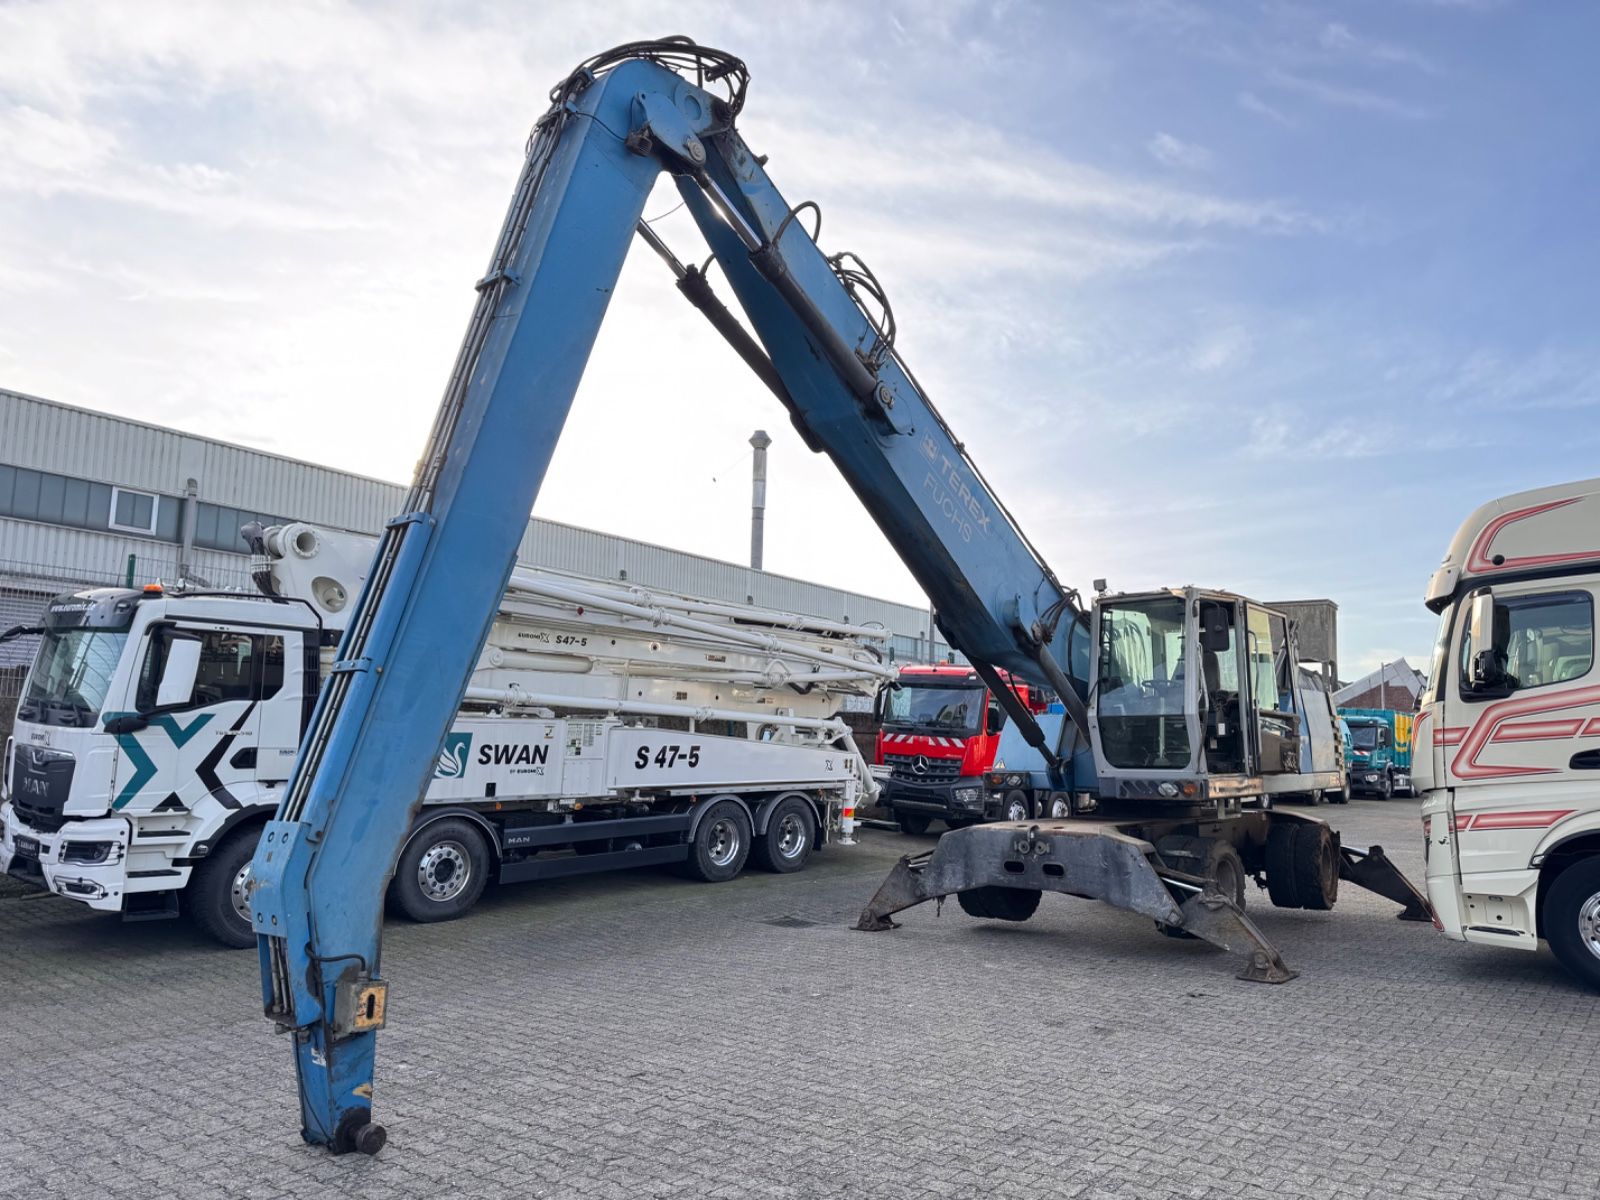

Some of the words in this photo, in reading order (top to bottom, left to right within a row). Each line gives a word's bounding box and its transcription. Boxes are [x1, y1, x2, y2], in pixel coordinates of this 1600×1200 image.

[942, 454, 991, 533] TEREX
[924, 472, 972, 542] FUCHS
[556, 634, 588, 647] S47-5
[478, 744, 549, 765] SWAN
[634, 745, 650, 770] S
[654, 745, 701, 769] 47-5
[22, 776, 50, 797] MAN
[508, 836, 530, 845] MAN
